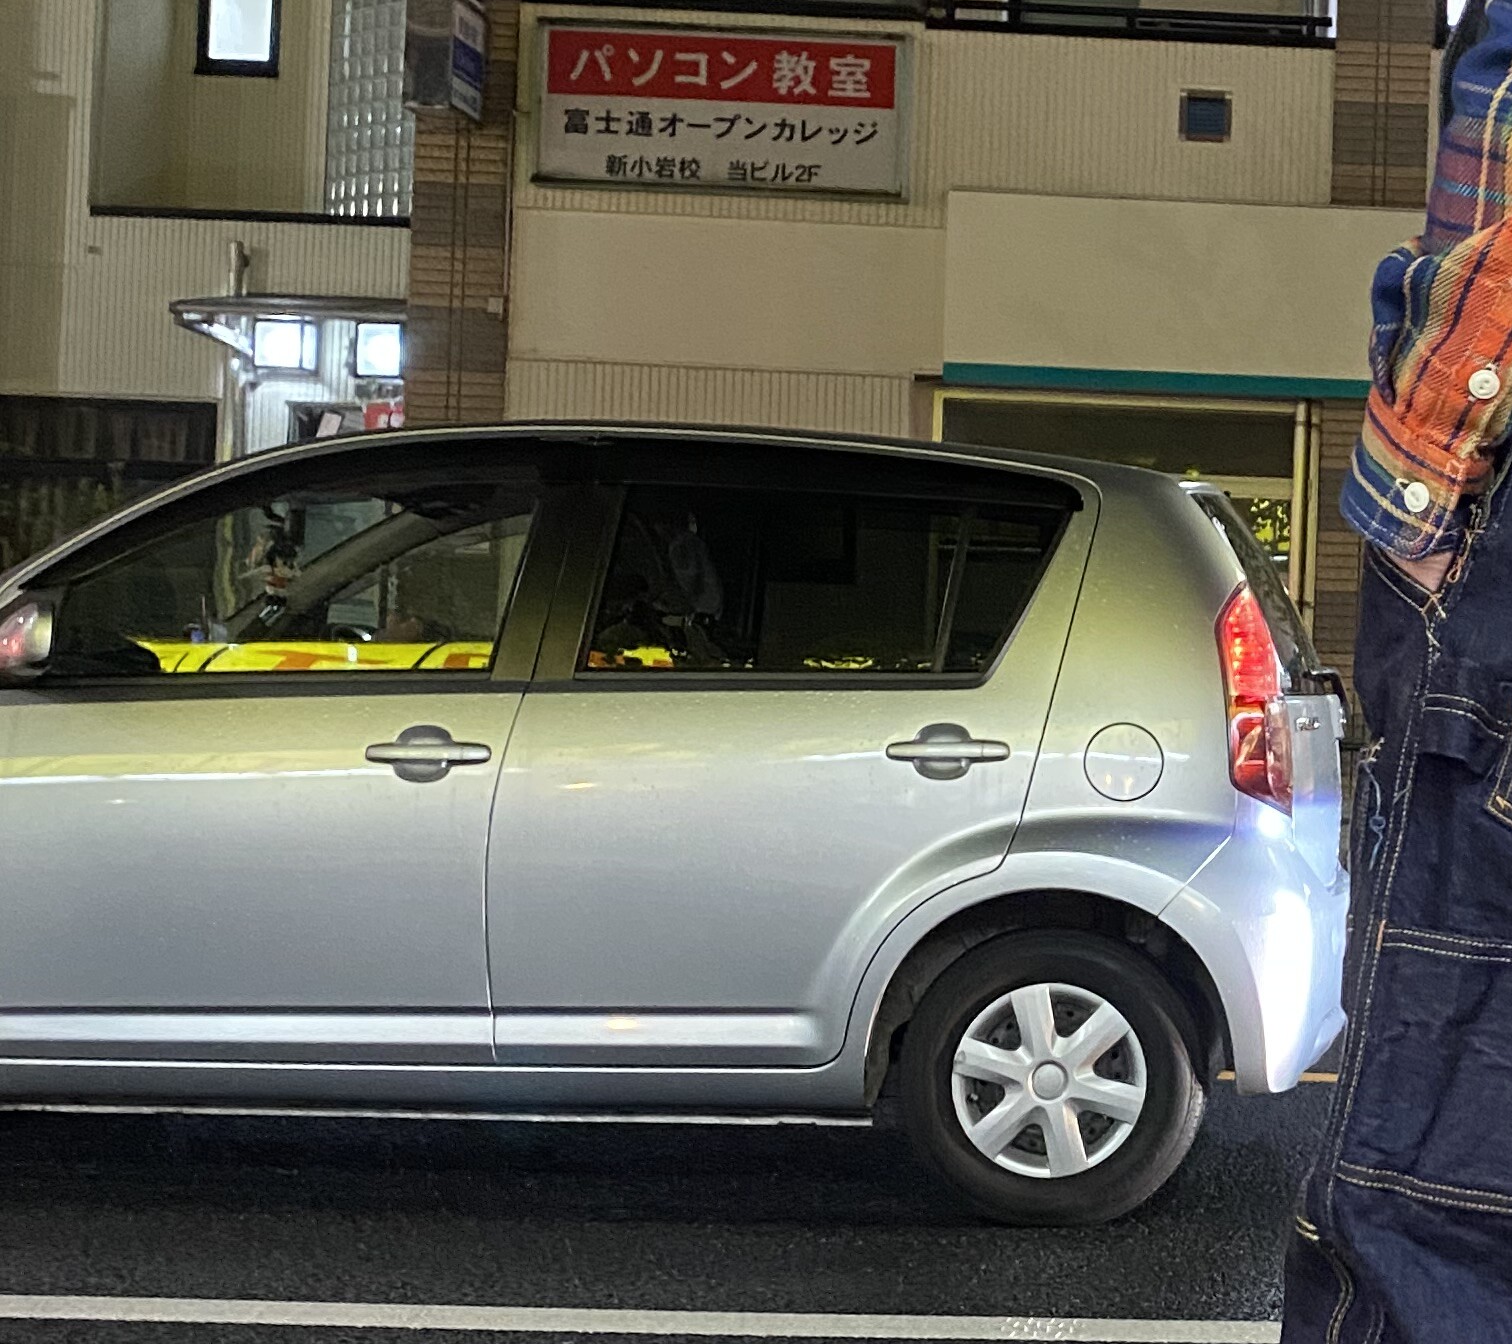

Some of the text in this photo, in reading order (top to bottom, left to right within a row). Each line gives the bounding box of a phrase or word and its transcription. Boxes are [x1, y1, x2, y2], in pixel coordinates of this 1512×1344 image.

[570, 44, 872, 99] パソコン教室
[563, 108, 878, 145] 富士通オープンカレッジ
[605, 154, 822, 184] 新小岩校 当ビル2F
